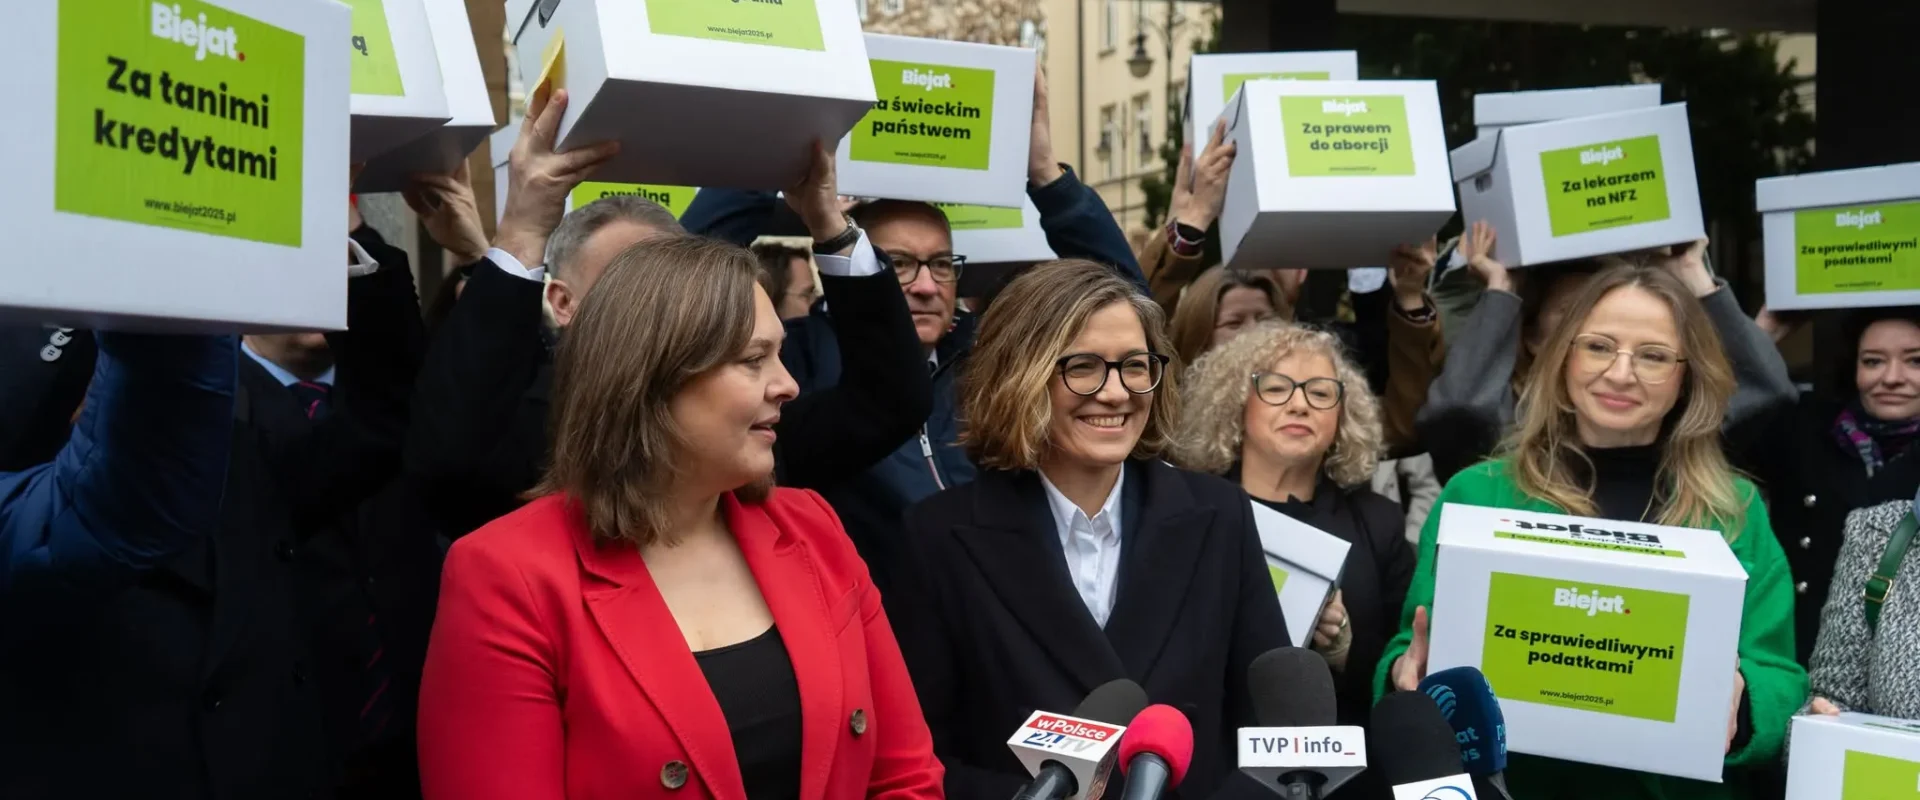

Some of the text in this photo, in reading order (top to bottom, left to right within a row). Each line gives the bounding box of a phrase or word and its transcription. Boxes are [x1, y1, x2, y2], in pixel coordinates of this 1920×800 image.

[152, 2, 246, 62] Biejat.
[707, 25, 774, 39] www.biejat2025.pl
[902, 69, 956, 91] Biejat.
[107, 55, 269, 129] Za tanimi
[892, 96, 981, 119] świeckim
[872, 118, 971, 139] państwem
[1302, 123, 1391, 137] Za prawem
[94, 108, 277, 181] kredytami
[1310, 138, 1389, 153] do aborcji
[1562, 169, 1656, 193] Za lekarzem
[1586, 189, 1638, 208] na NFZ
[144, 197, 237, 225] www.biejat2025.pl
[1801, 237, 1917, 257] Za sprawiedliwymi
[1824, 253, 1893, 270] podatkami
[1554, 587, 1631, 617] Biejat.
[1494, 624, 1675, 661] Za sprawiedliwymi
[1527, 650, 1634, 675] podatkami
[1540, 688, 1614, 707] www.biejat2025.pl
[1036, 719, 1107, 741] wPolsce
[1249, 737, 1289, 753] TVP
